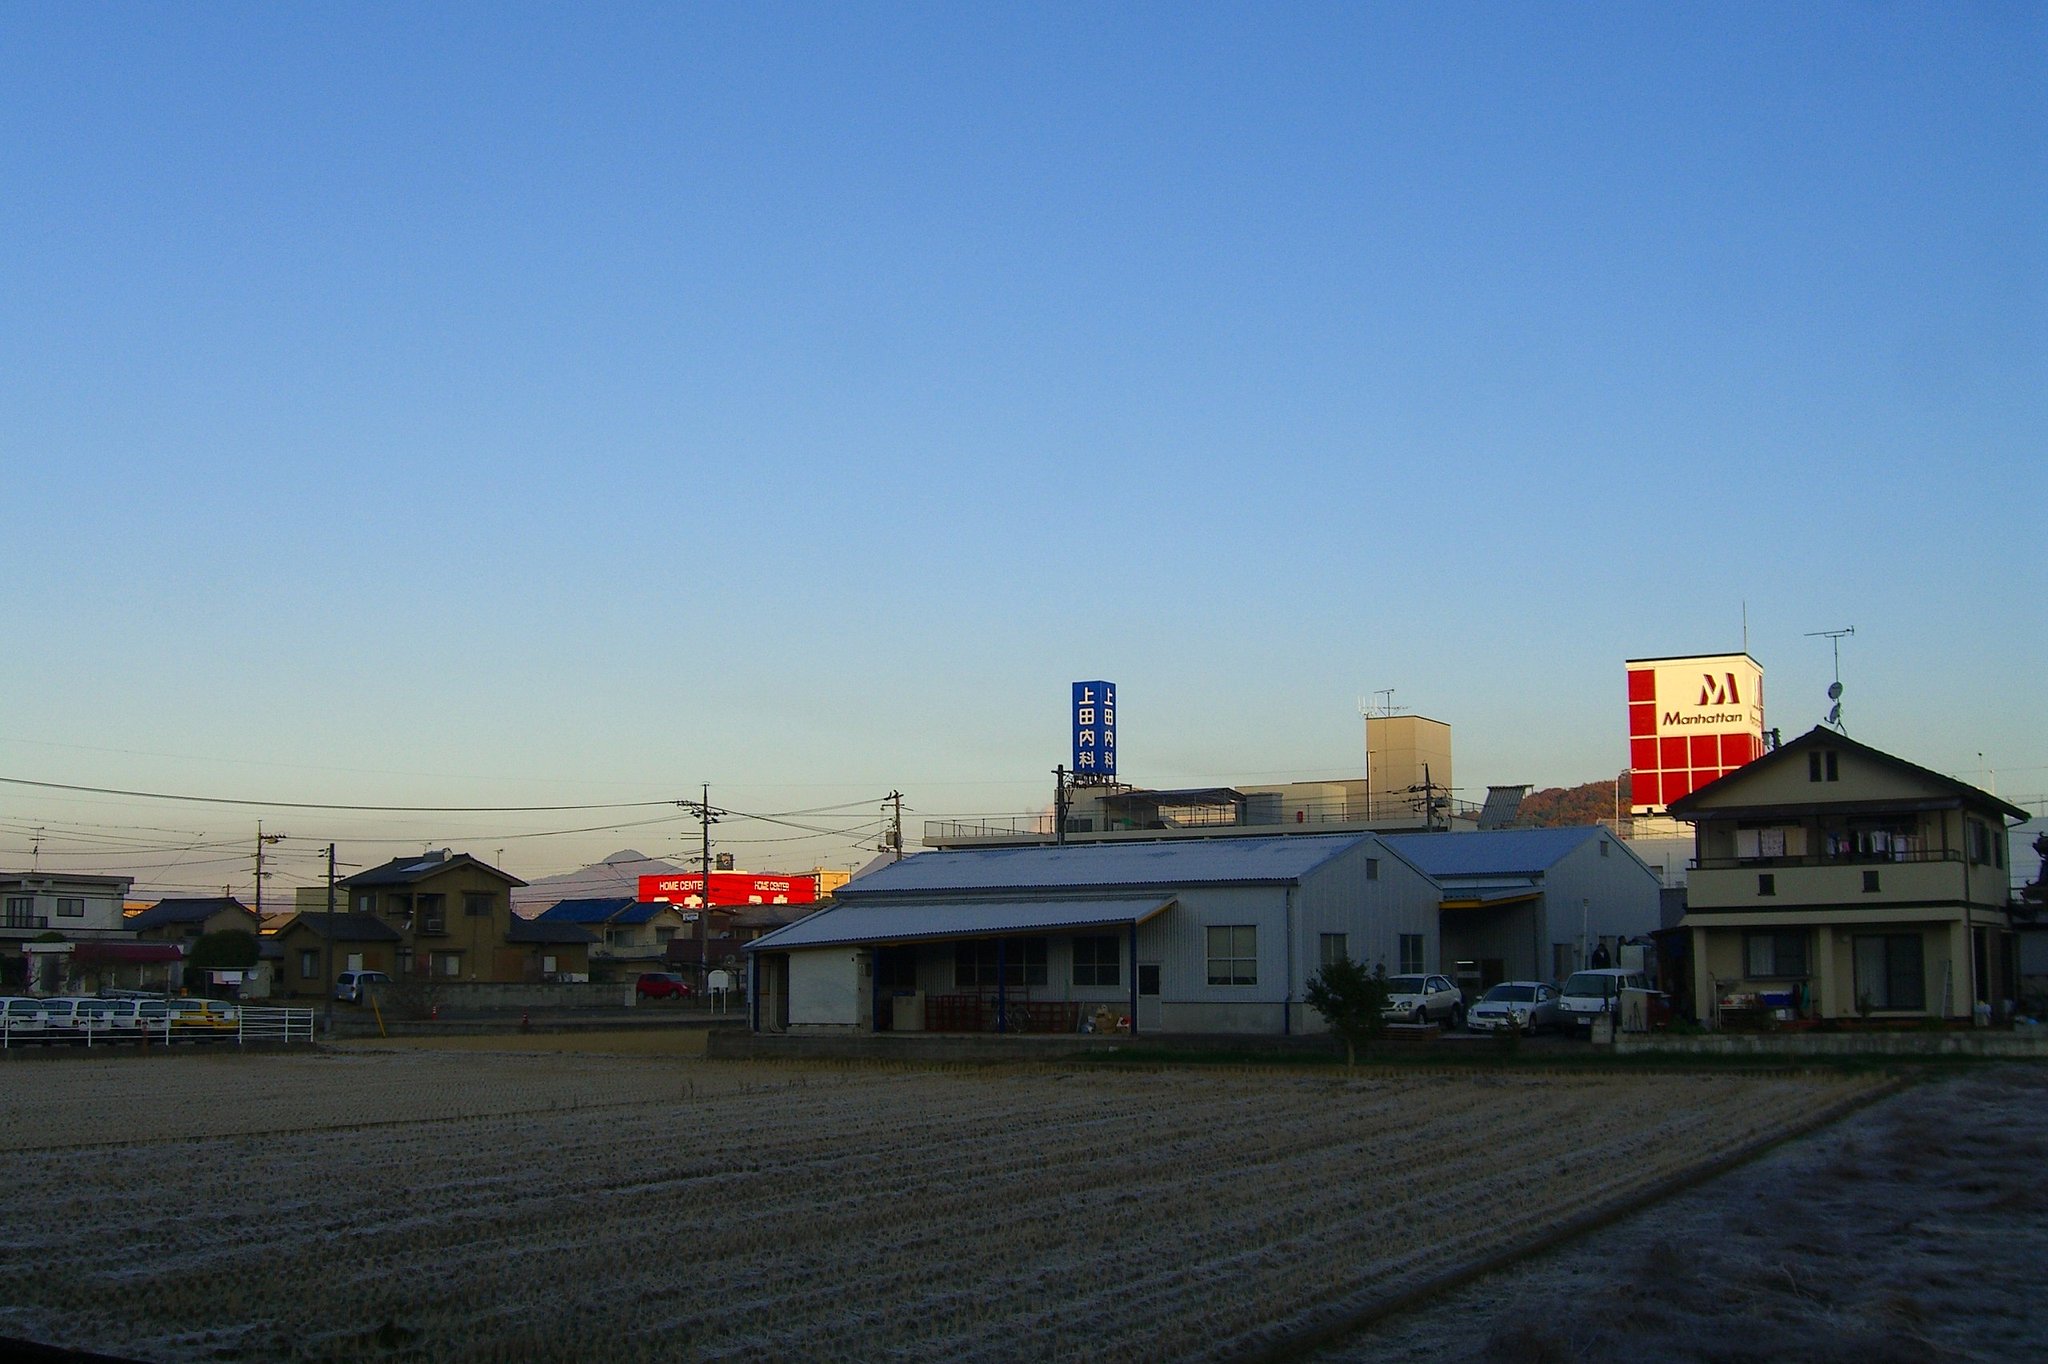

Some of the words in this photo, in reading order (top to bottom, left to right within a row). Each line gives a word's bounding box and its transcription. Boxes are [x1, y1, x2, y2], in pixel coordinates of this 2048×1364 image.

[1663, 711, 1742, 725] Manhattan
[1078, 687, 1095, 769] 上田内科
[1104, 687, 1113, 769] 上田内科
[659, 881, 679, 890] HOME
[754, 881, 769, 890] HOME
[770, 882, 790, 891] CENTER
